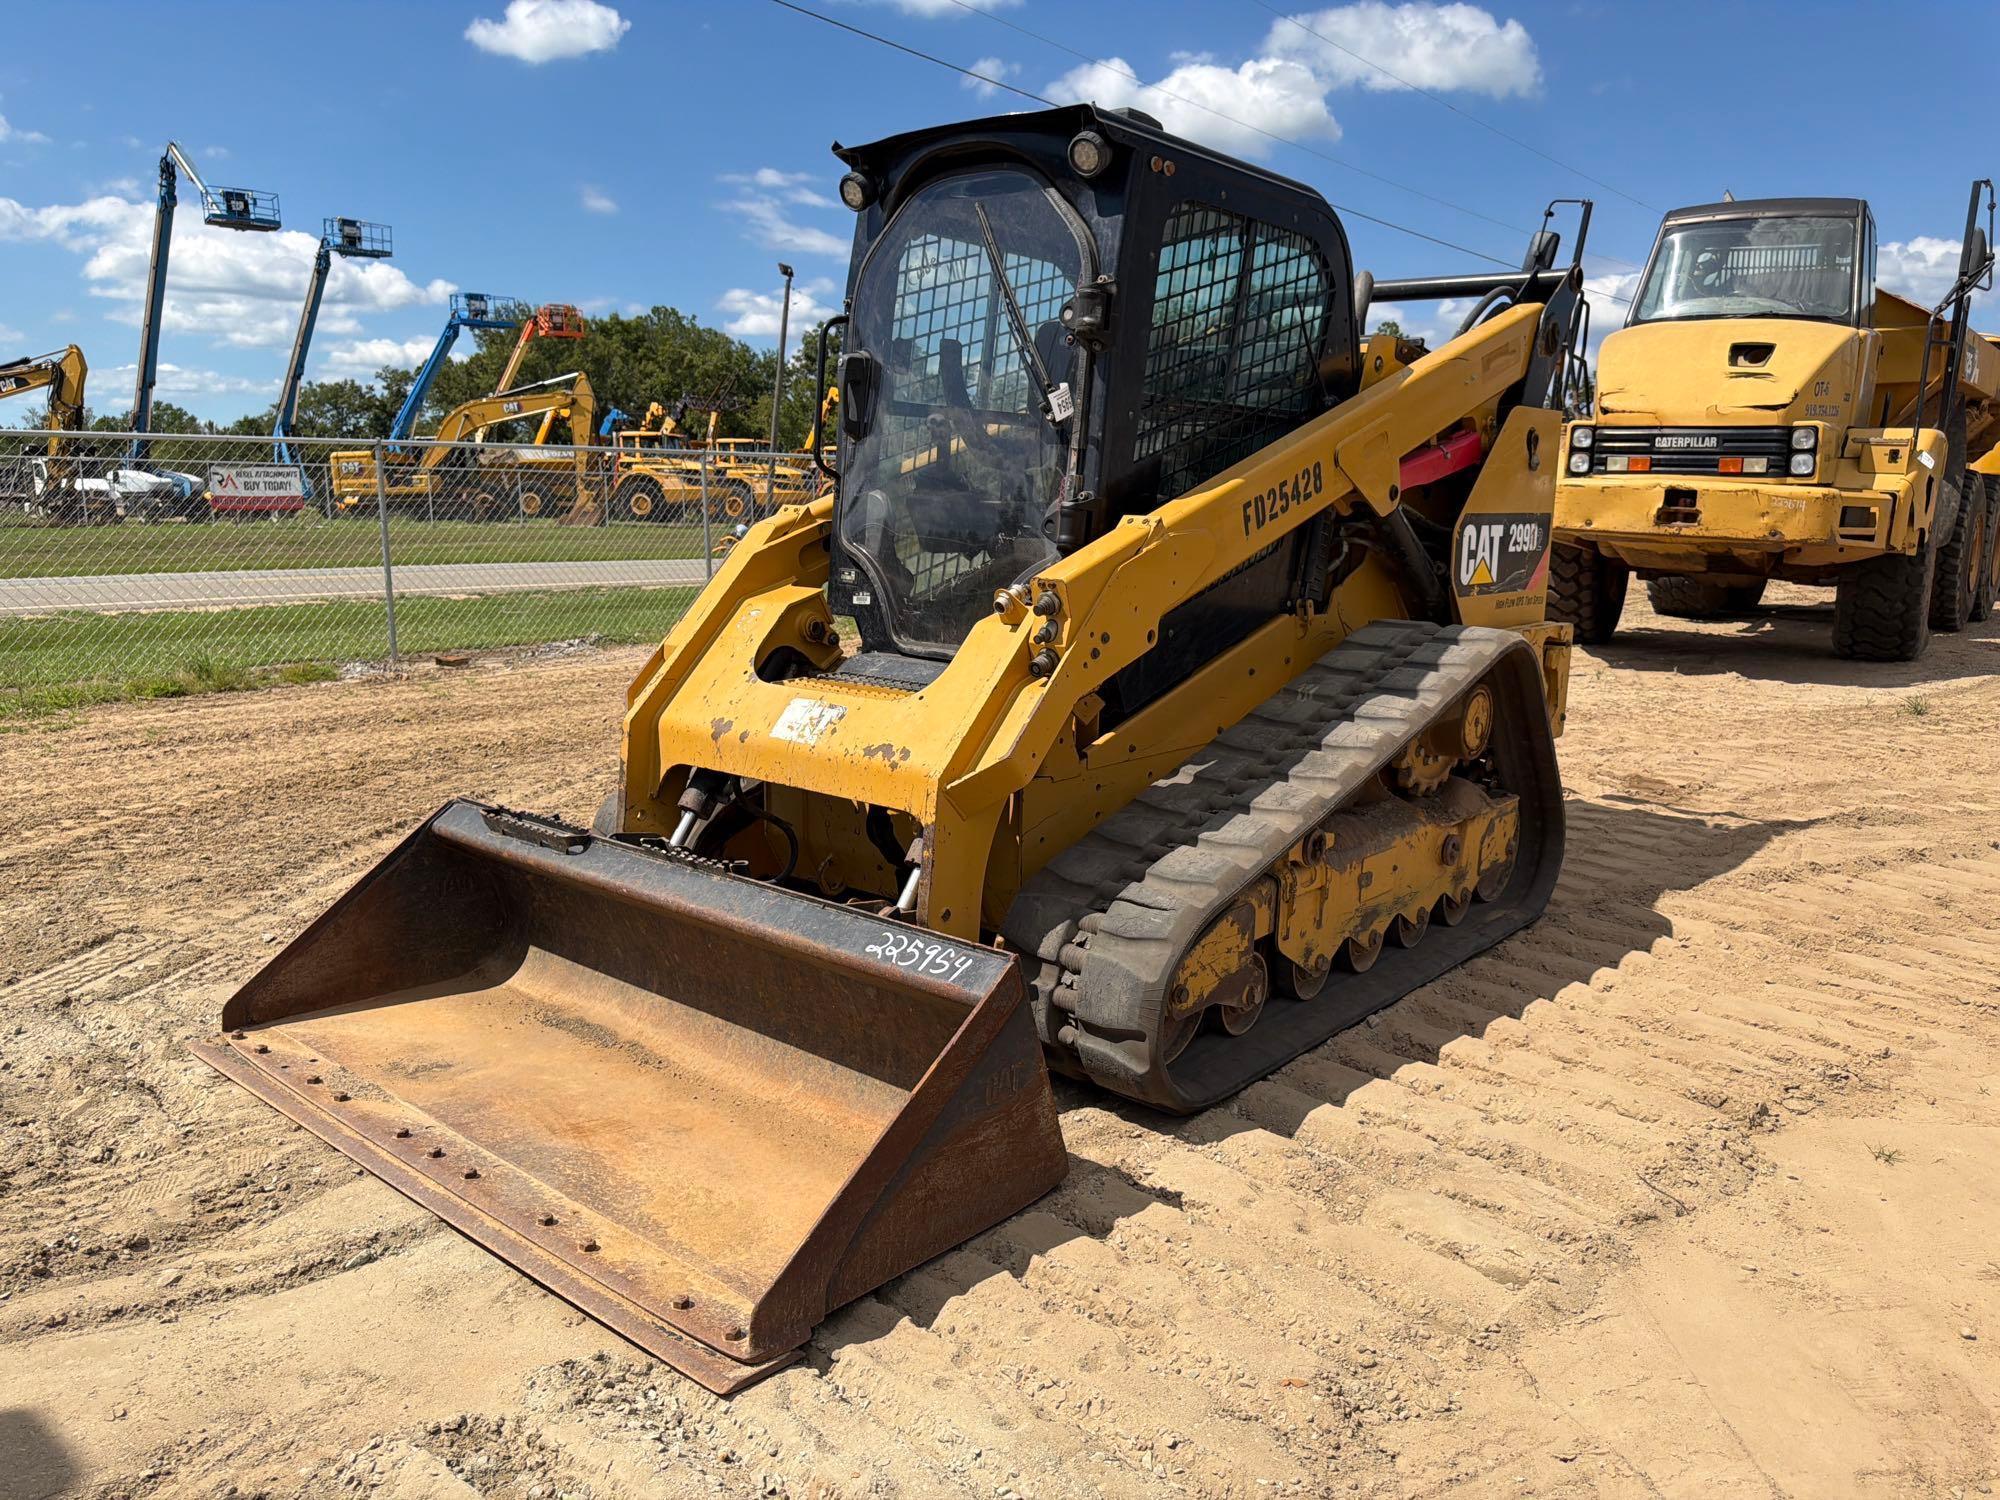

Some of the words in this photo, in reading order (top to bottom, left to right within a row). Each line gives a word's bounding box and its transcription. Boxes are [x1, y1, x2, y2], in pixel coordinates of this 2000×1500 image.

[0, 376, 17, 392] CAT
[503, 401, 519, 413] CAT
[1655, 436, 1717, 448] CATERPILLAR
[543, 449, 575, 459] VOLVO
[341, 461, 360, 474] CAT
[254, 470, 298, 478] ATTACHMENTS
[244, 481, 260, 491] BUY
[263, 481, 292, 491] TODAY!
[1242, 460, 1322, 537] FD25428
[1461, 524, 1504, 586] CAT
[865, 932, 973, 982] 225954
